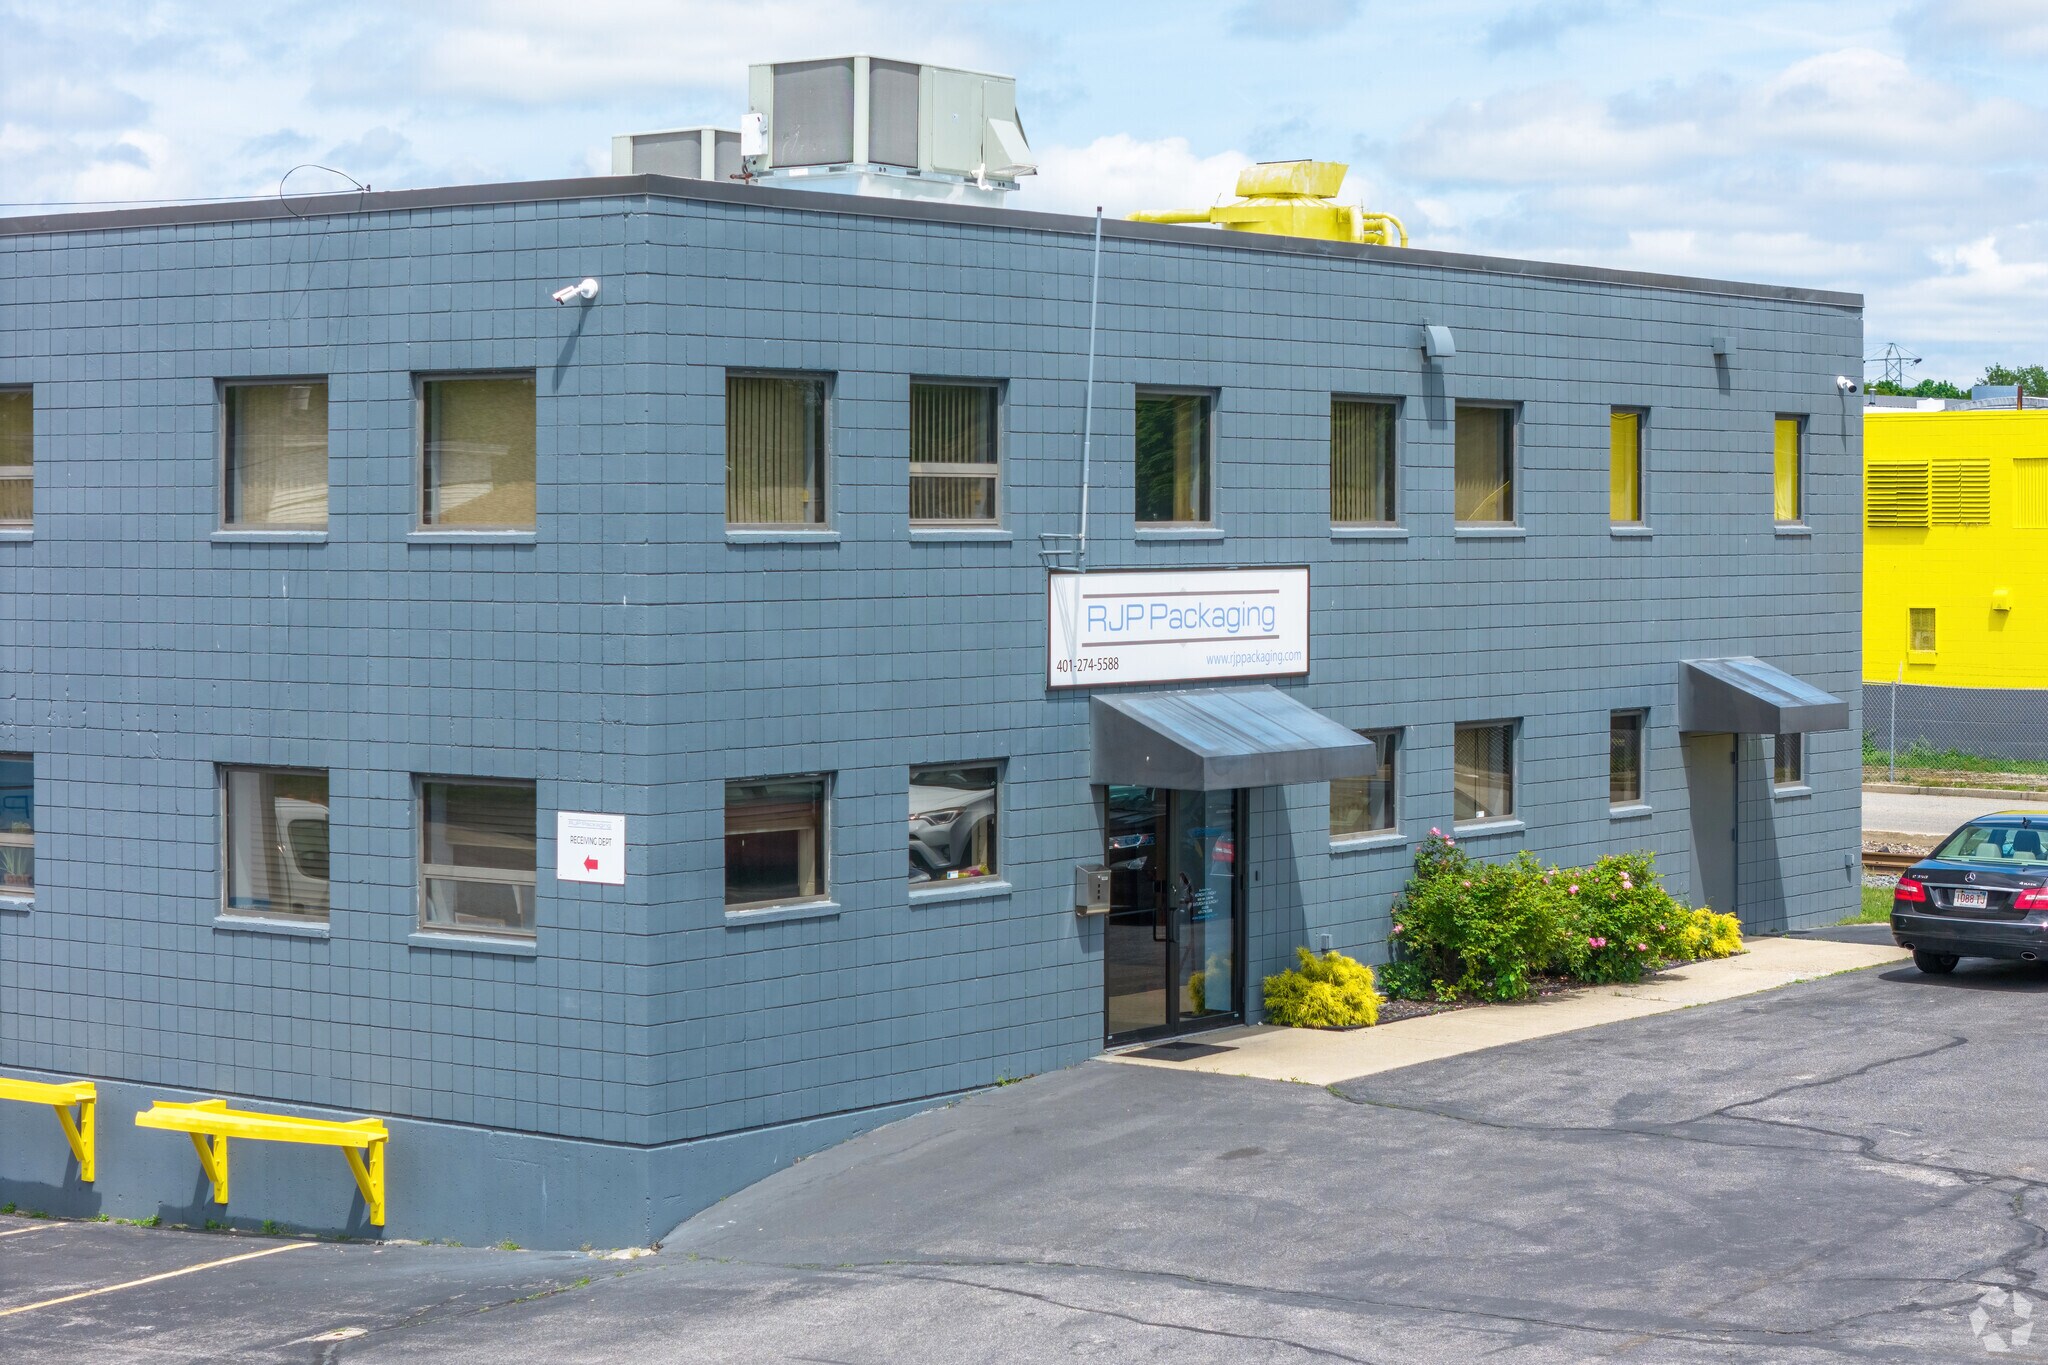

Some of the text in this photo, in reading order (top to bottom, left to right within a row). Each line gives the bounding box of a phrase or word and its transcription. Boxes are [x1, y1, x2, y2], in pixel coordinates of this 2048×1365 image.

[1087, 601, 1276, 634] RJP Packaging
[1056, 657, 1119, 672] 401-274-5588
[1205, 650, 1302, 667] www.rjppackaging.com
[570, 835, 612, 847] RECEIVING DEPT
